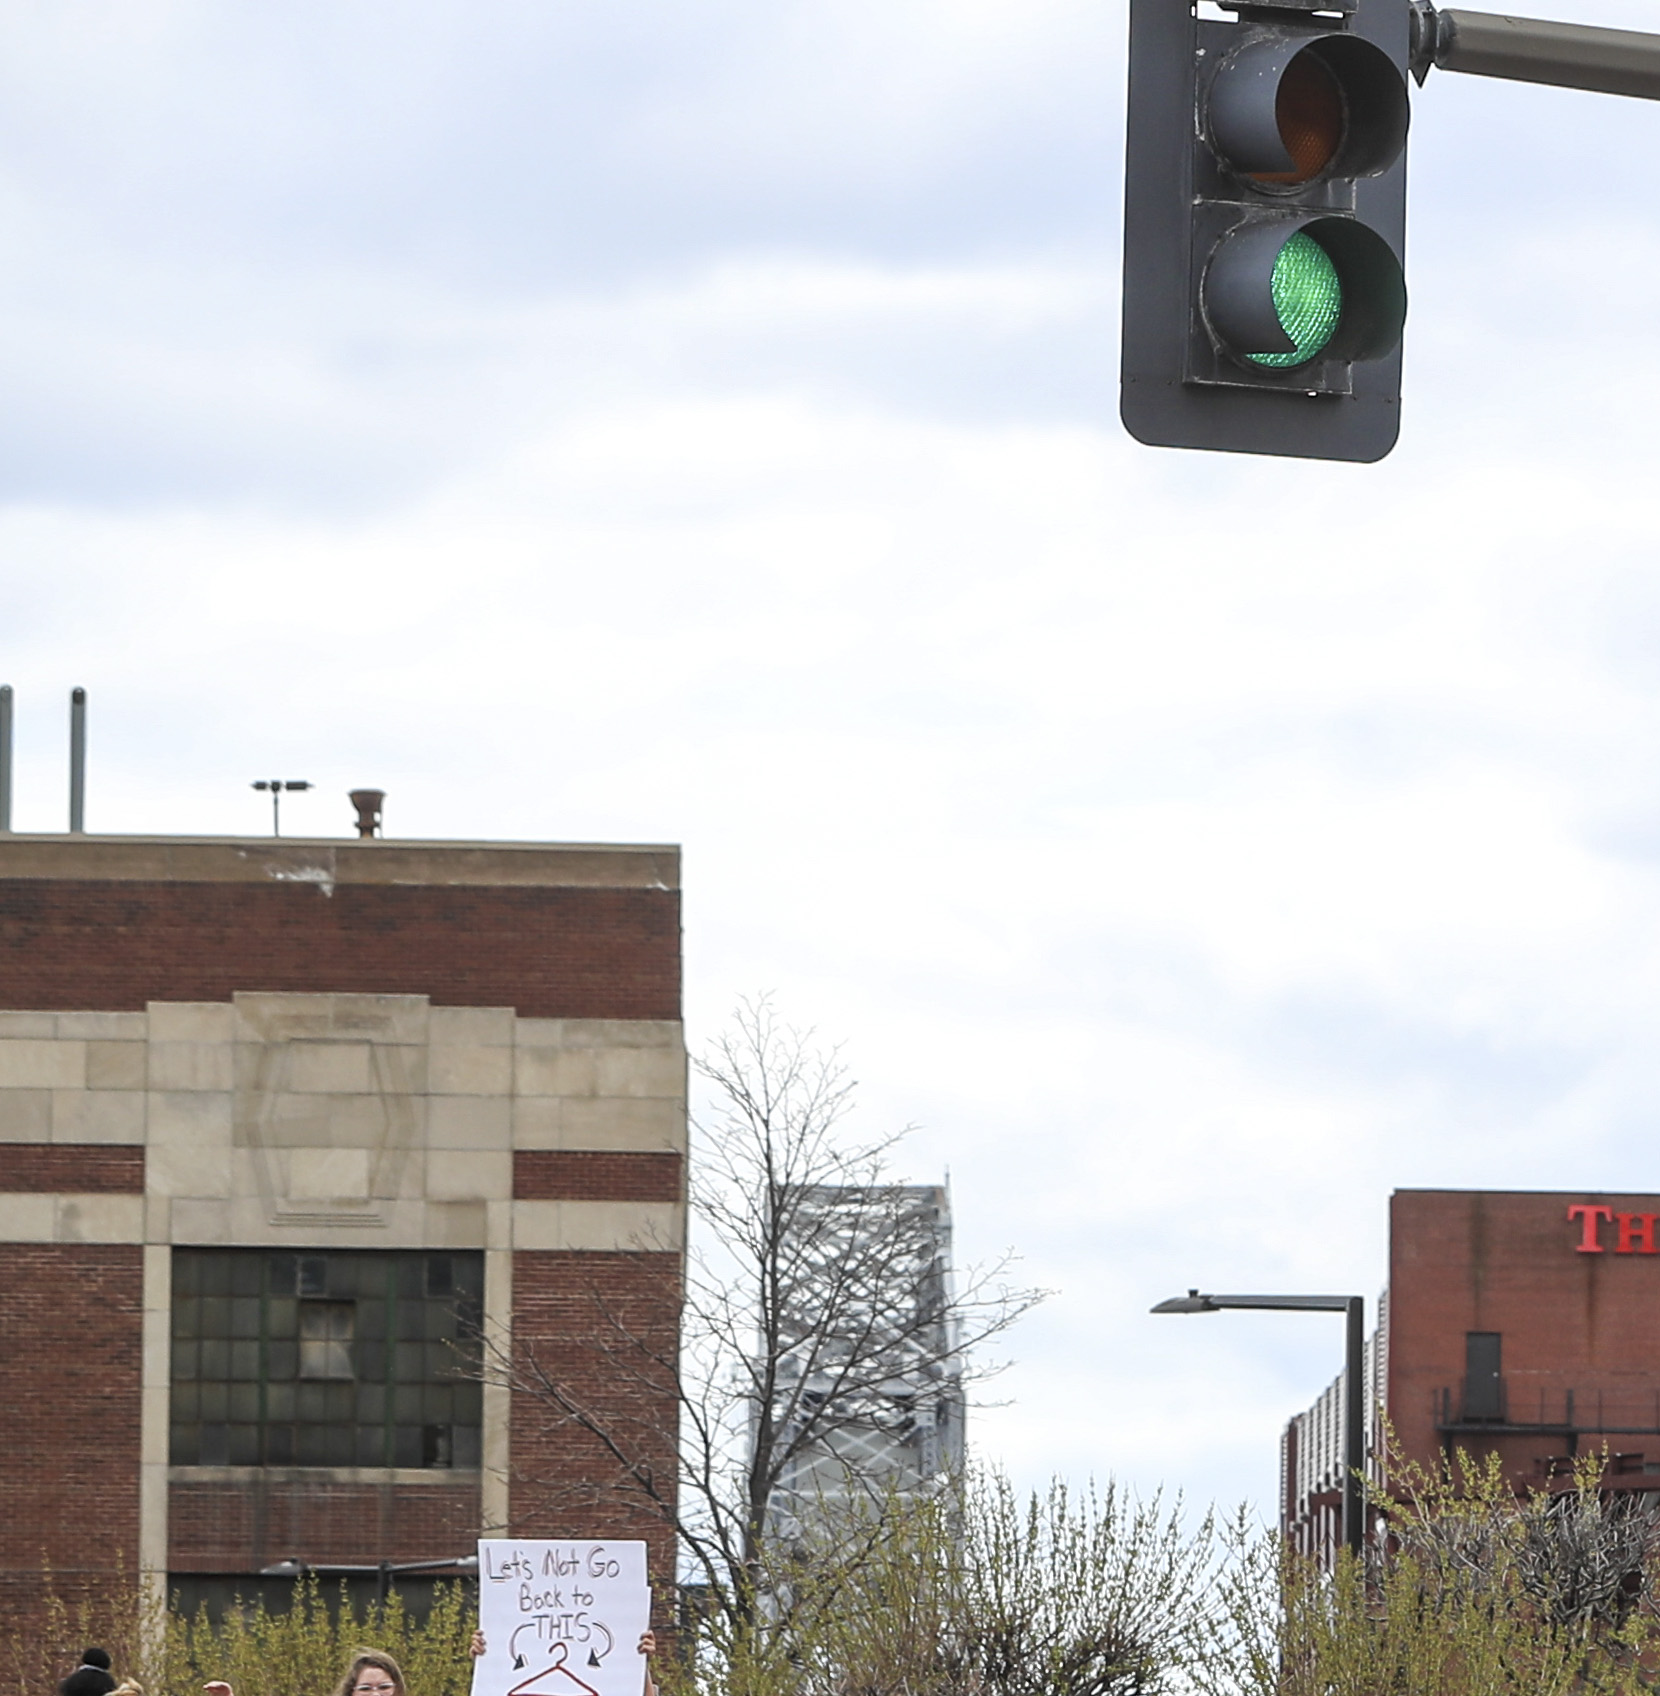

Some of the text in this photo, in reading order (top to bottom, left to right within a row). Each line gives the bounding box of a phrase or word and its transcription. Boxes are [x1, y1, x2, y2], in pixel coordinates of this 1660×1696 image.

[485, 1545, 620, 1580] Let's Not Go
[519, 1583, 594, 1612] Back to
[532, 1612, 591, 1642] THIS
